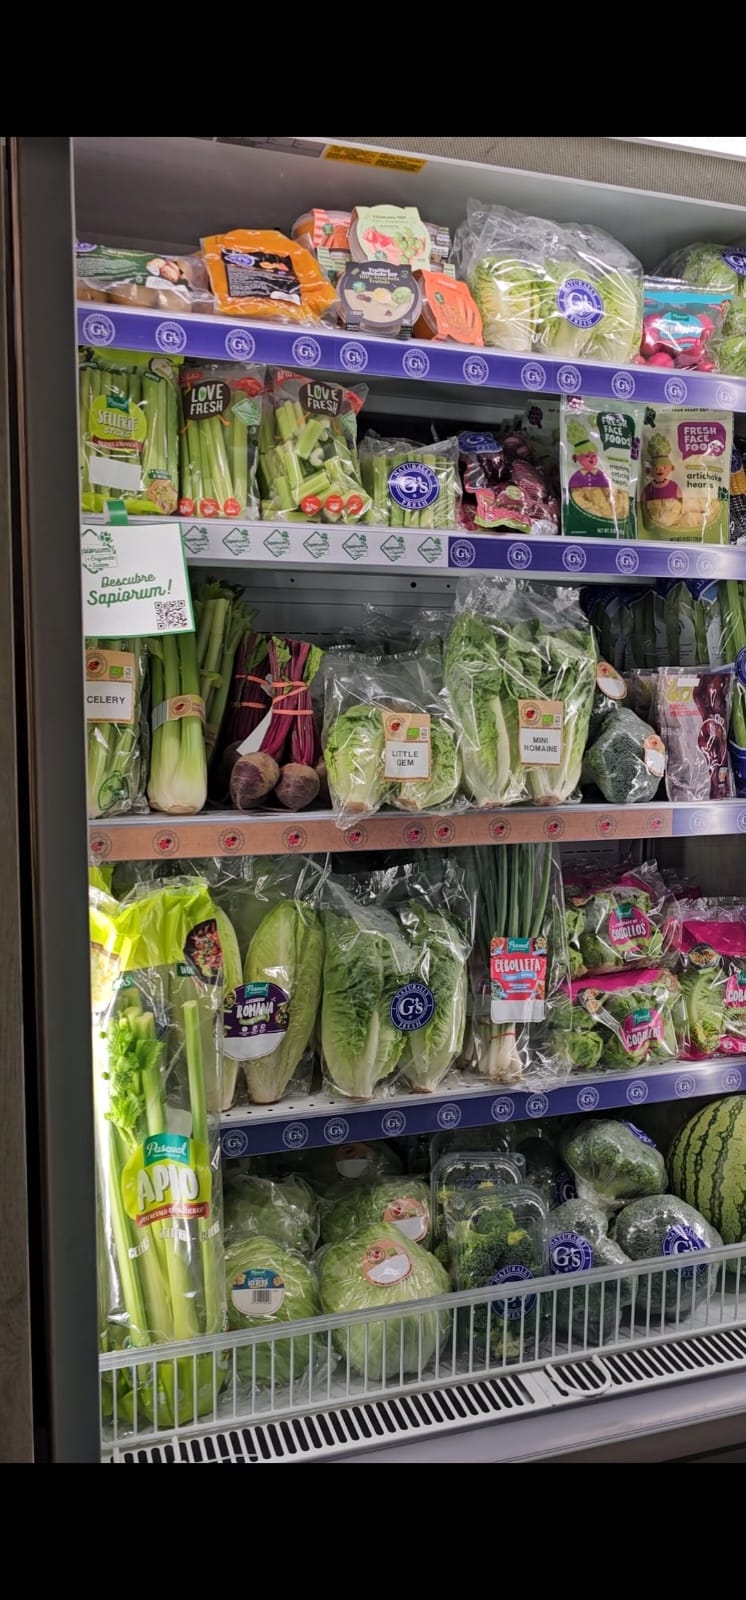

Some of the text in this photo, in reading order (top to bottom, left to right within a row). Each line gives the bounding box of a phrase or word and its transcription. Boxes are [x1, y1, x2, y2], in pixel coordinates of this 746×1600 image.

[192, 384, 224, 402] LOVE
[308, 384, 338, 401] LOVE
[190, 400, 223, 415] FRESH
[308, 397, 338, 415] FRESH
[602, 416, 628, 428] FRESH
[604, 424, 622, 436] FACE
[684, 426, 717, 435] FRESH
[605, 434, 631, 446] FOODS
[684, 435, 710, 443] FACE
[686, 442, 721, 452] FOODS
[686, 472, 722, 482] artichoke
[400, 476, 428, 494] G's
[686, 481, 714, 489] hears
[402, 499, 428, 508] FRESH
[101, 573, 156, 588] Descubre
[86, 695, 125, 704] CELERY
[392, 750, 419, 758] LITTLE
[524, 744, 558, 752] ROMAINE
[396, 758, 414, 766] GEM
[495, 958, 540, 972] CEBOLLETA
[236, 1001, 274, 1018] ROMANA
[400, 998, 424, 1015] G's
[399, 1020, 422, 1029] FRESH
[227, 1137, 242, 1148] G's
[146, 1141, 187, 1157] Pascual
[136, 1164, 199, 1212] APIO
[552, 1246, 580, 1267] G's
